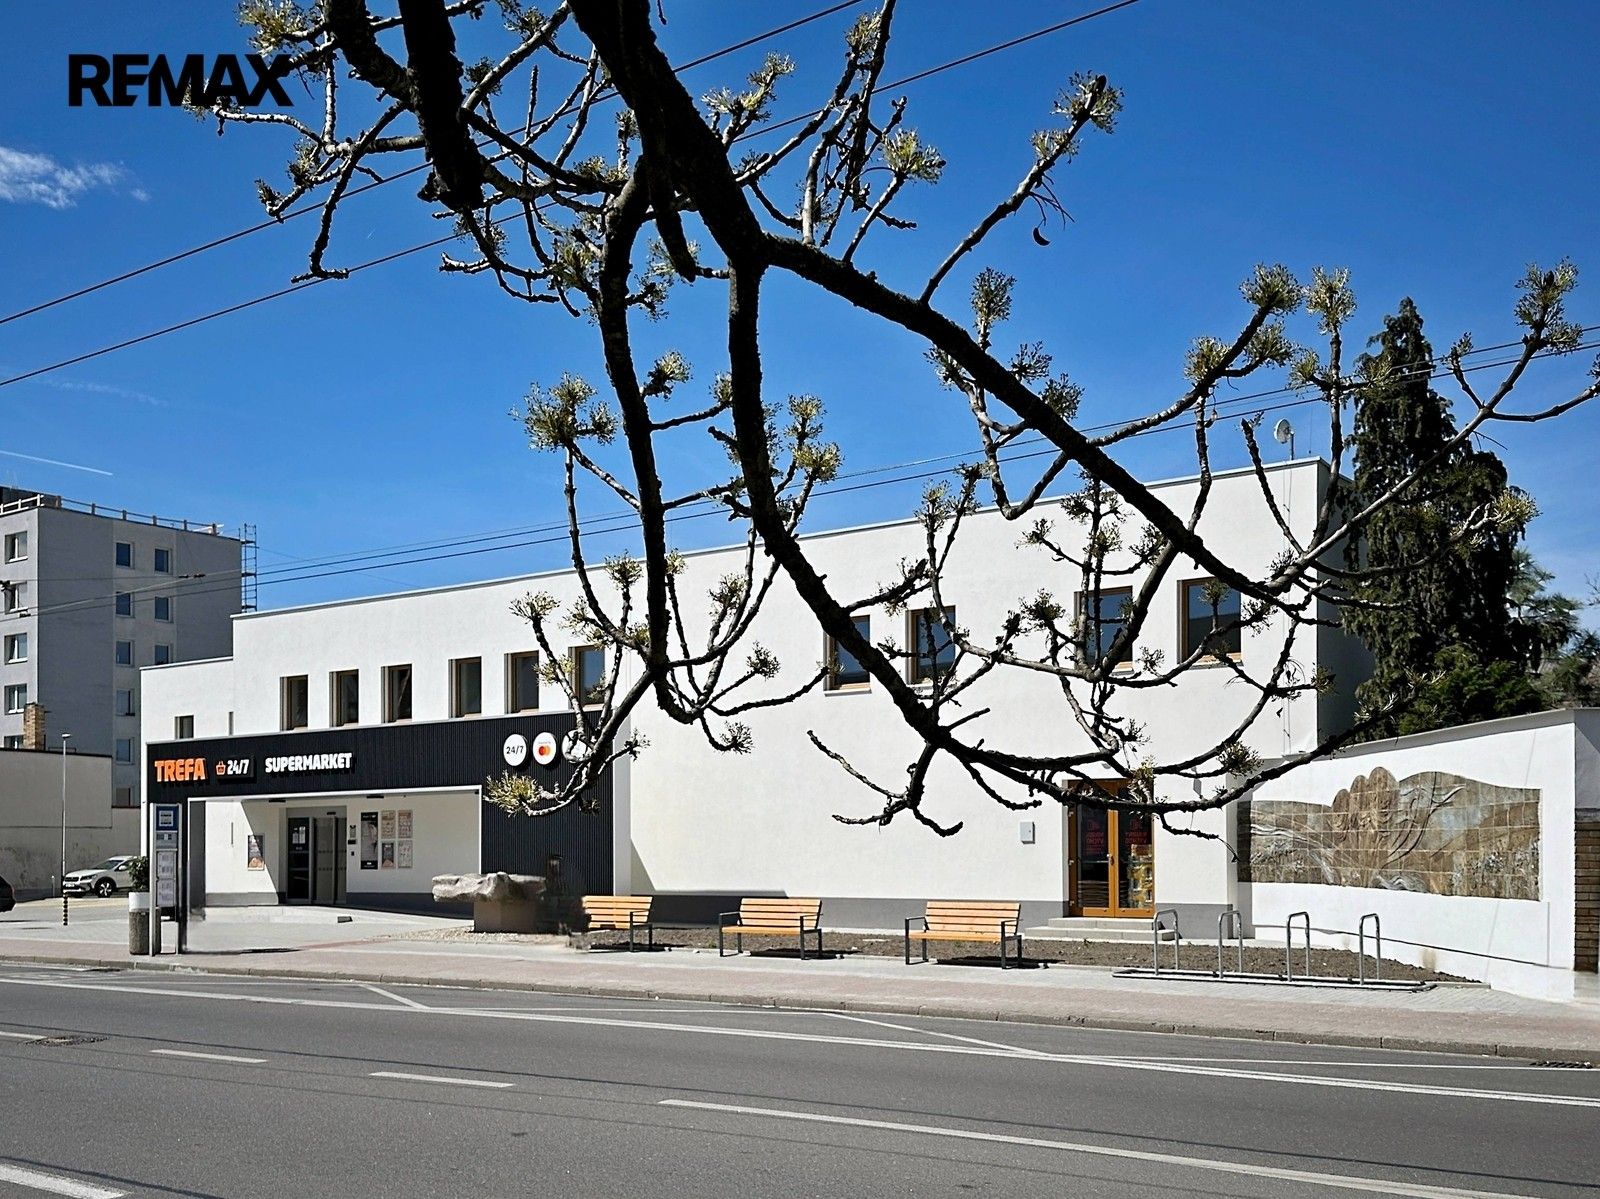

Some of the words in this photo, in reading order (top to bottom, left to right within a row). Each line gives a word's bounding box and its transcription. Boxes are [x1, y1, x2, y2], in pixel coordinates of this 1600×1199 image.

[506, 746, 524, 755] 24/7
[154, 757, 206, 782] TREFA
[227, 759, 250, 775] 24/7
[265, 752, 352, 773] SUPERMARKET
